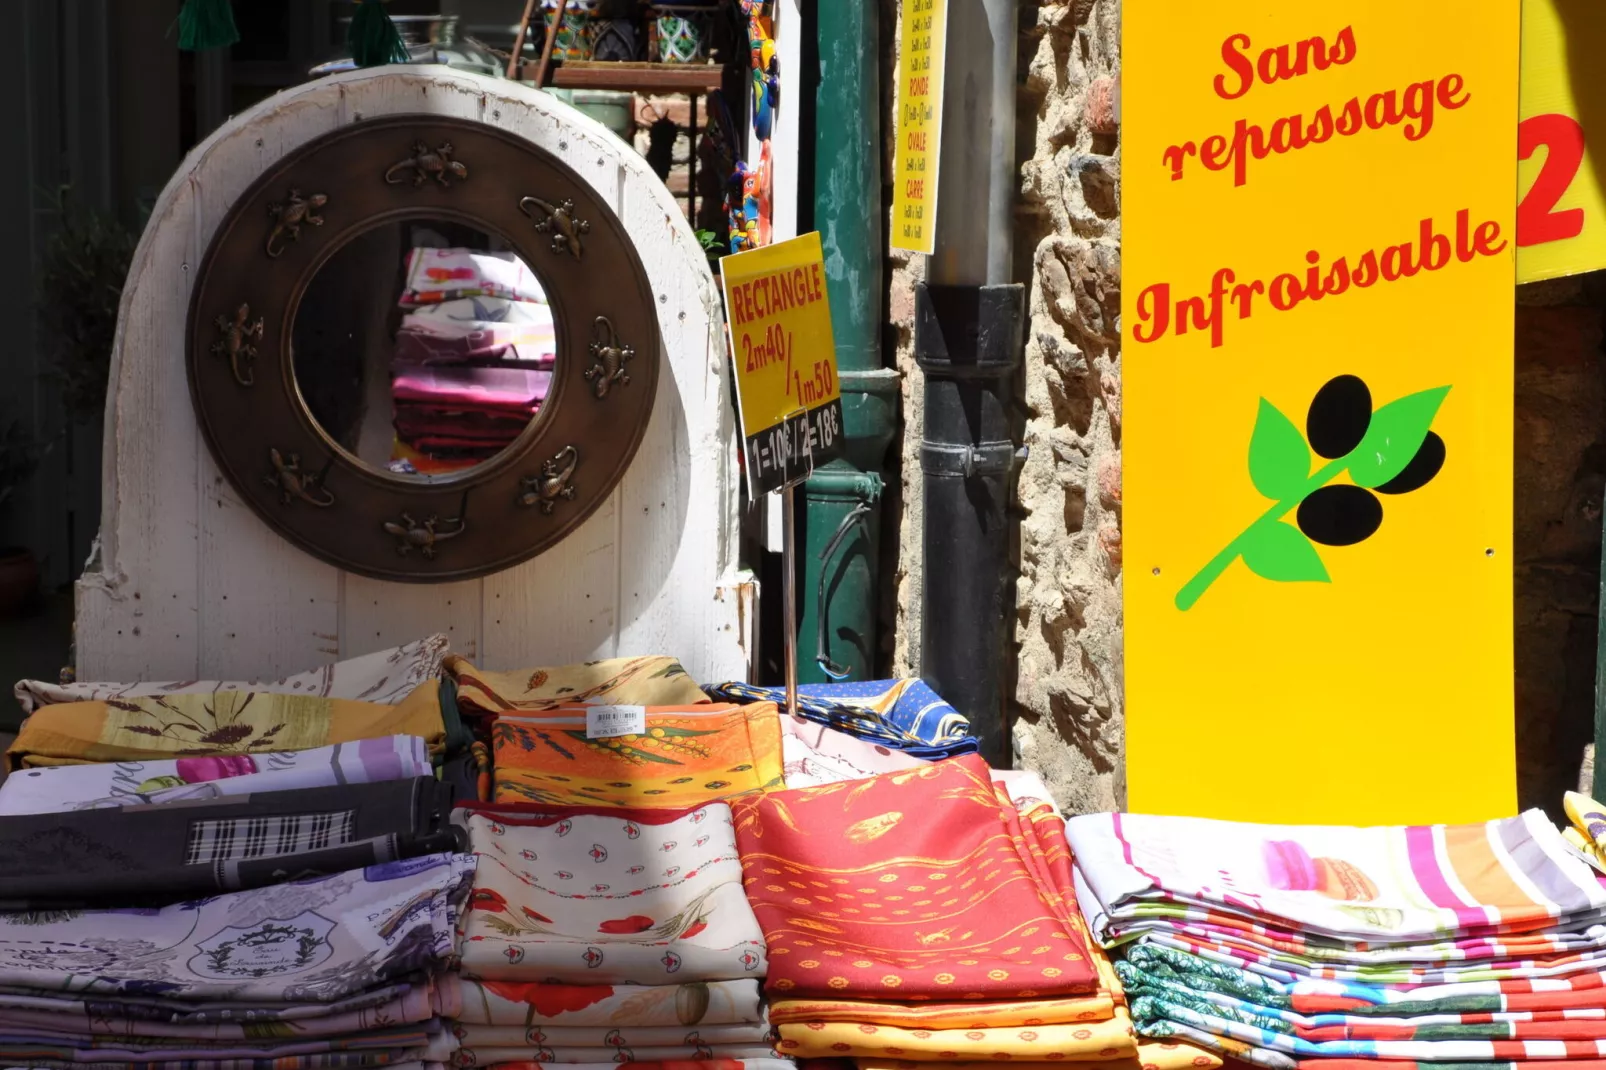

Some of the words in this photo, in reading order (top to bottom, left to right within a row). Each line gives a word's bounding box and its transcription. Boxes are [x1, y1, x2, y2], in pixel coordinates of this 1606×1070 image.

[910, 77, 929, 96] RONDE
[1213, 25, 1356, 100] Sans
[908, 132, 927, 151] OVALE
[1162, 73, 1472, 188] repassage
[1516, 113, 1585, 248] 2
[732, 263, 822, 325] RECTANGLE
[1132, 208, 1508, 349] Infroissable
[793, 359, 833, 406] 1m50
